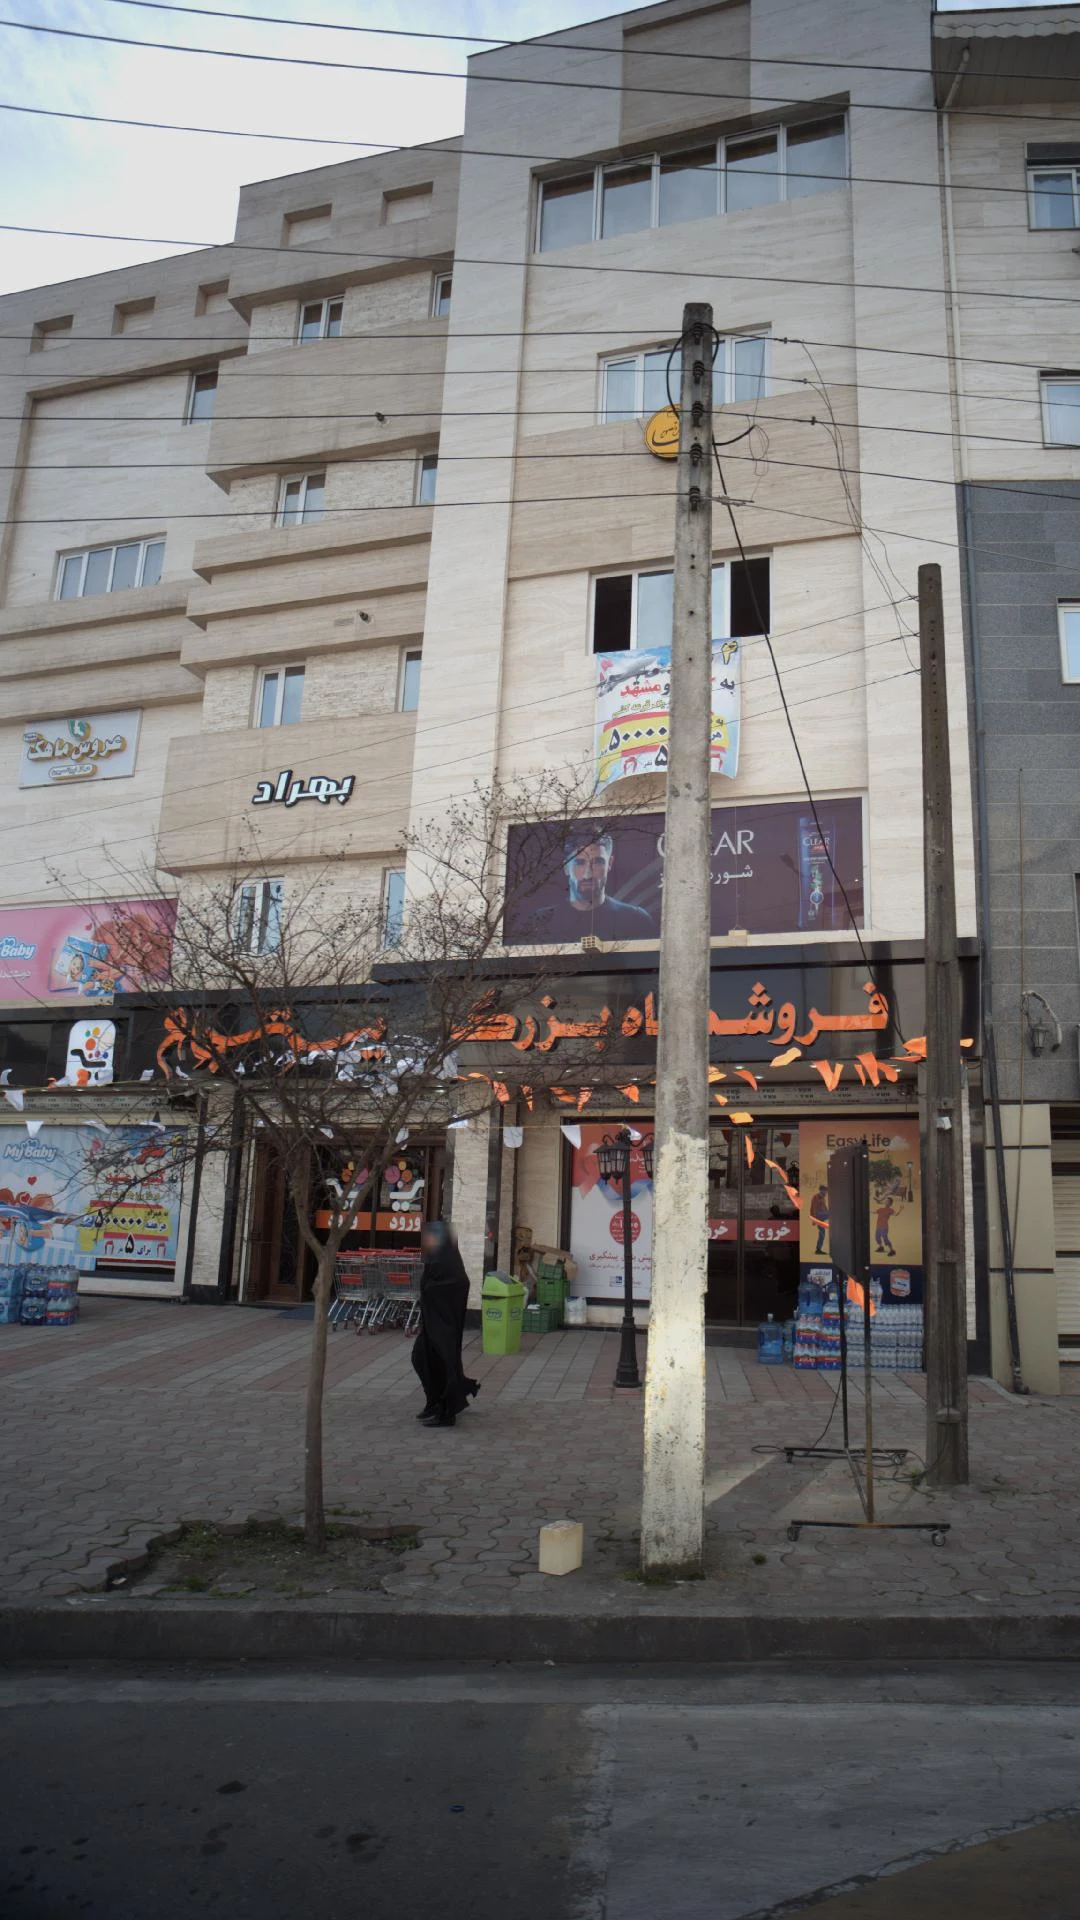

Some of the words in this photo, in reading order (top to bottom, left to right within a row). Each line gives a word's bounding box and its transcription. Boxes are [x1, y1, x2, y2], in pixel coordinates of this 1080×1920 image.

[252, 769, 356, 808] بهراد
[621, 981, 889, 1046] فروشاه
[4, 1143, 23, 1161] My
[24, 1144, 57, 1162] Baby
[389, 1216, 421, 1232] ورود
[754, 1221, 791, 1241] خروج
[124, 1234, 135, 1254] ۵
